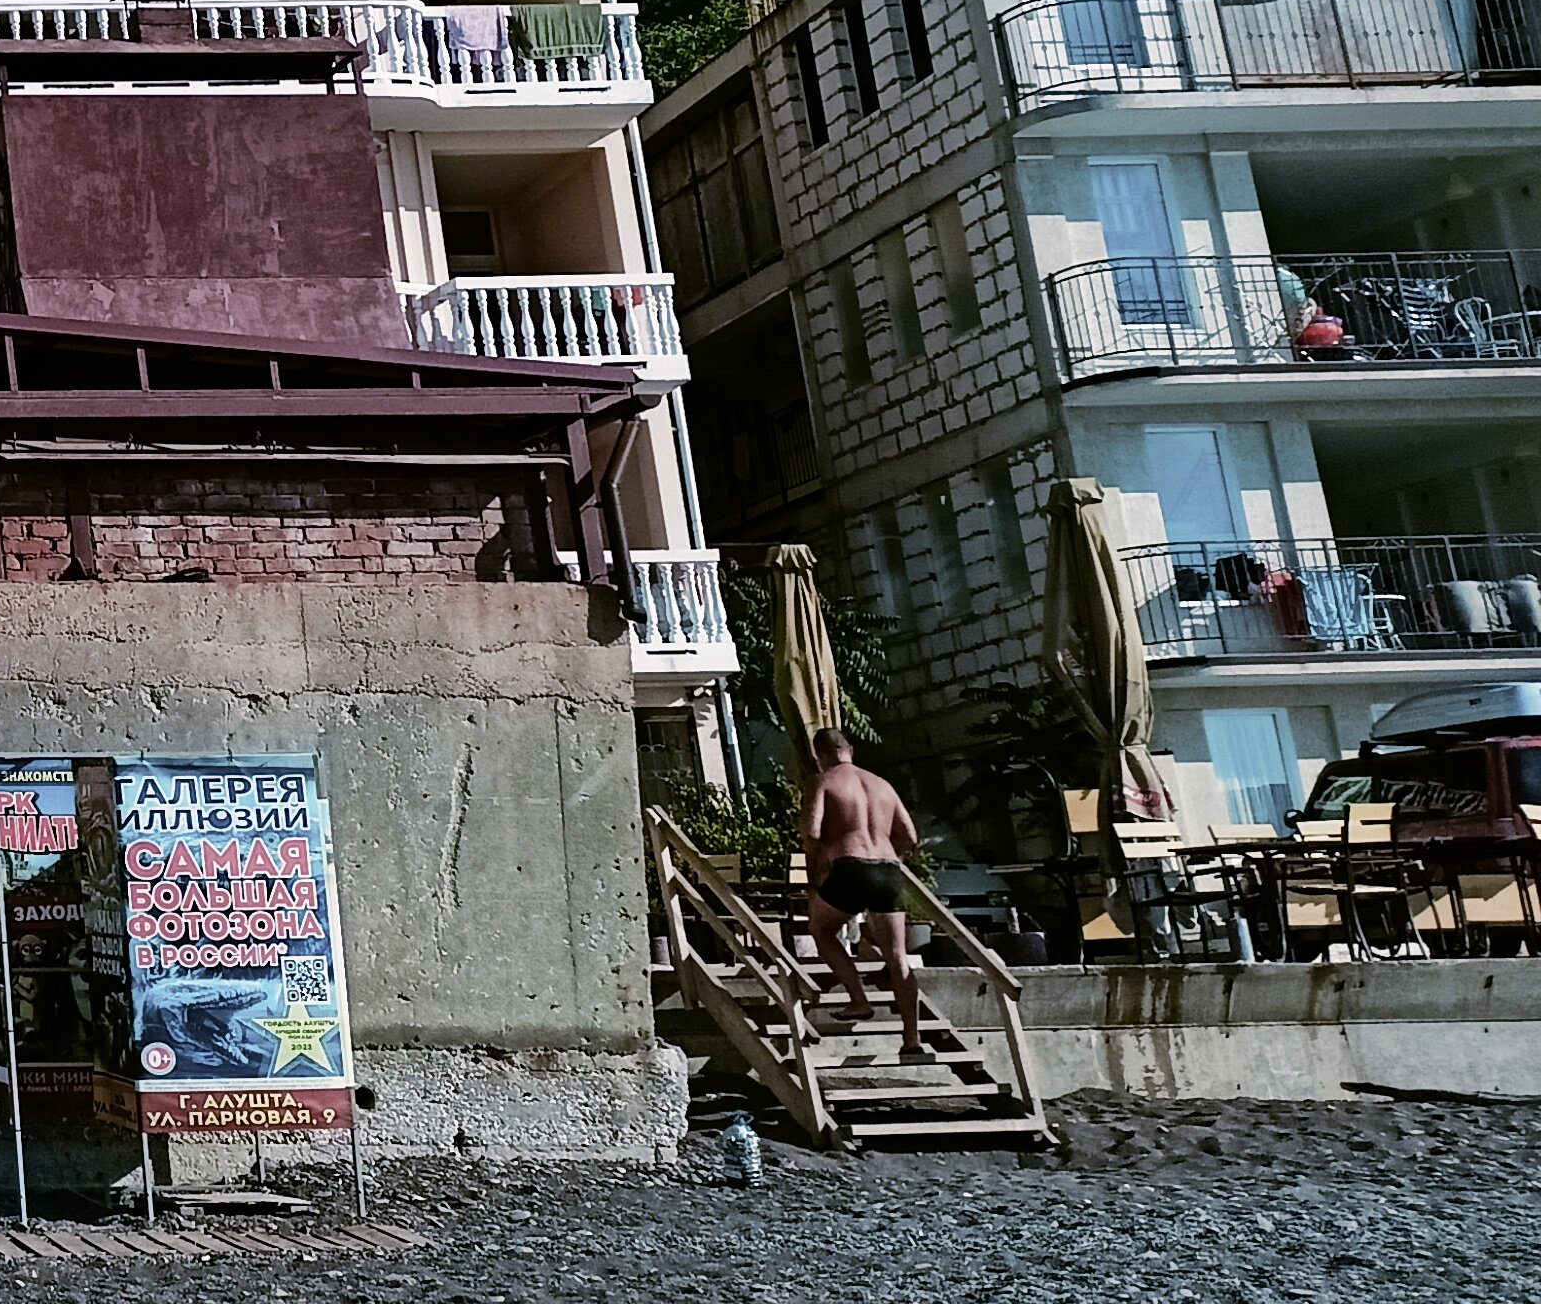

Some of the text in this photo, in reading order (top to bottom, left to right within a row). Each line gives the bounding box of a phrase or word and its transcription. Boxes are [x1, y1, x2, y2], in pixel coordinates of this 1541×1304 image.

[114, 776, 305, 805] ГАЛЕРЕЯ
[116, 804, 309, 830] ИЛЛЮЗИЙ
[125, 838, 311, 880] САМАЯ
[128, 880, 318, 911] БОЛЬШАЯ
[127, 910, 324, 942] ФОТОЗОНА
[136, 946, 155, 968] В
[147, 1052, 171, 1069] 0+
[179, 1093, 303, 1110] Г. АЛУШТА,
[146, 1109, 337, 1128] УЛ. ПАРКОВАЯ, 9
